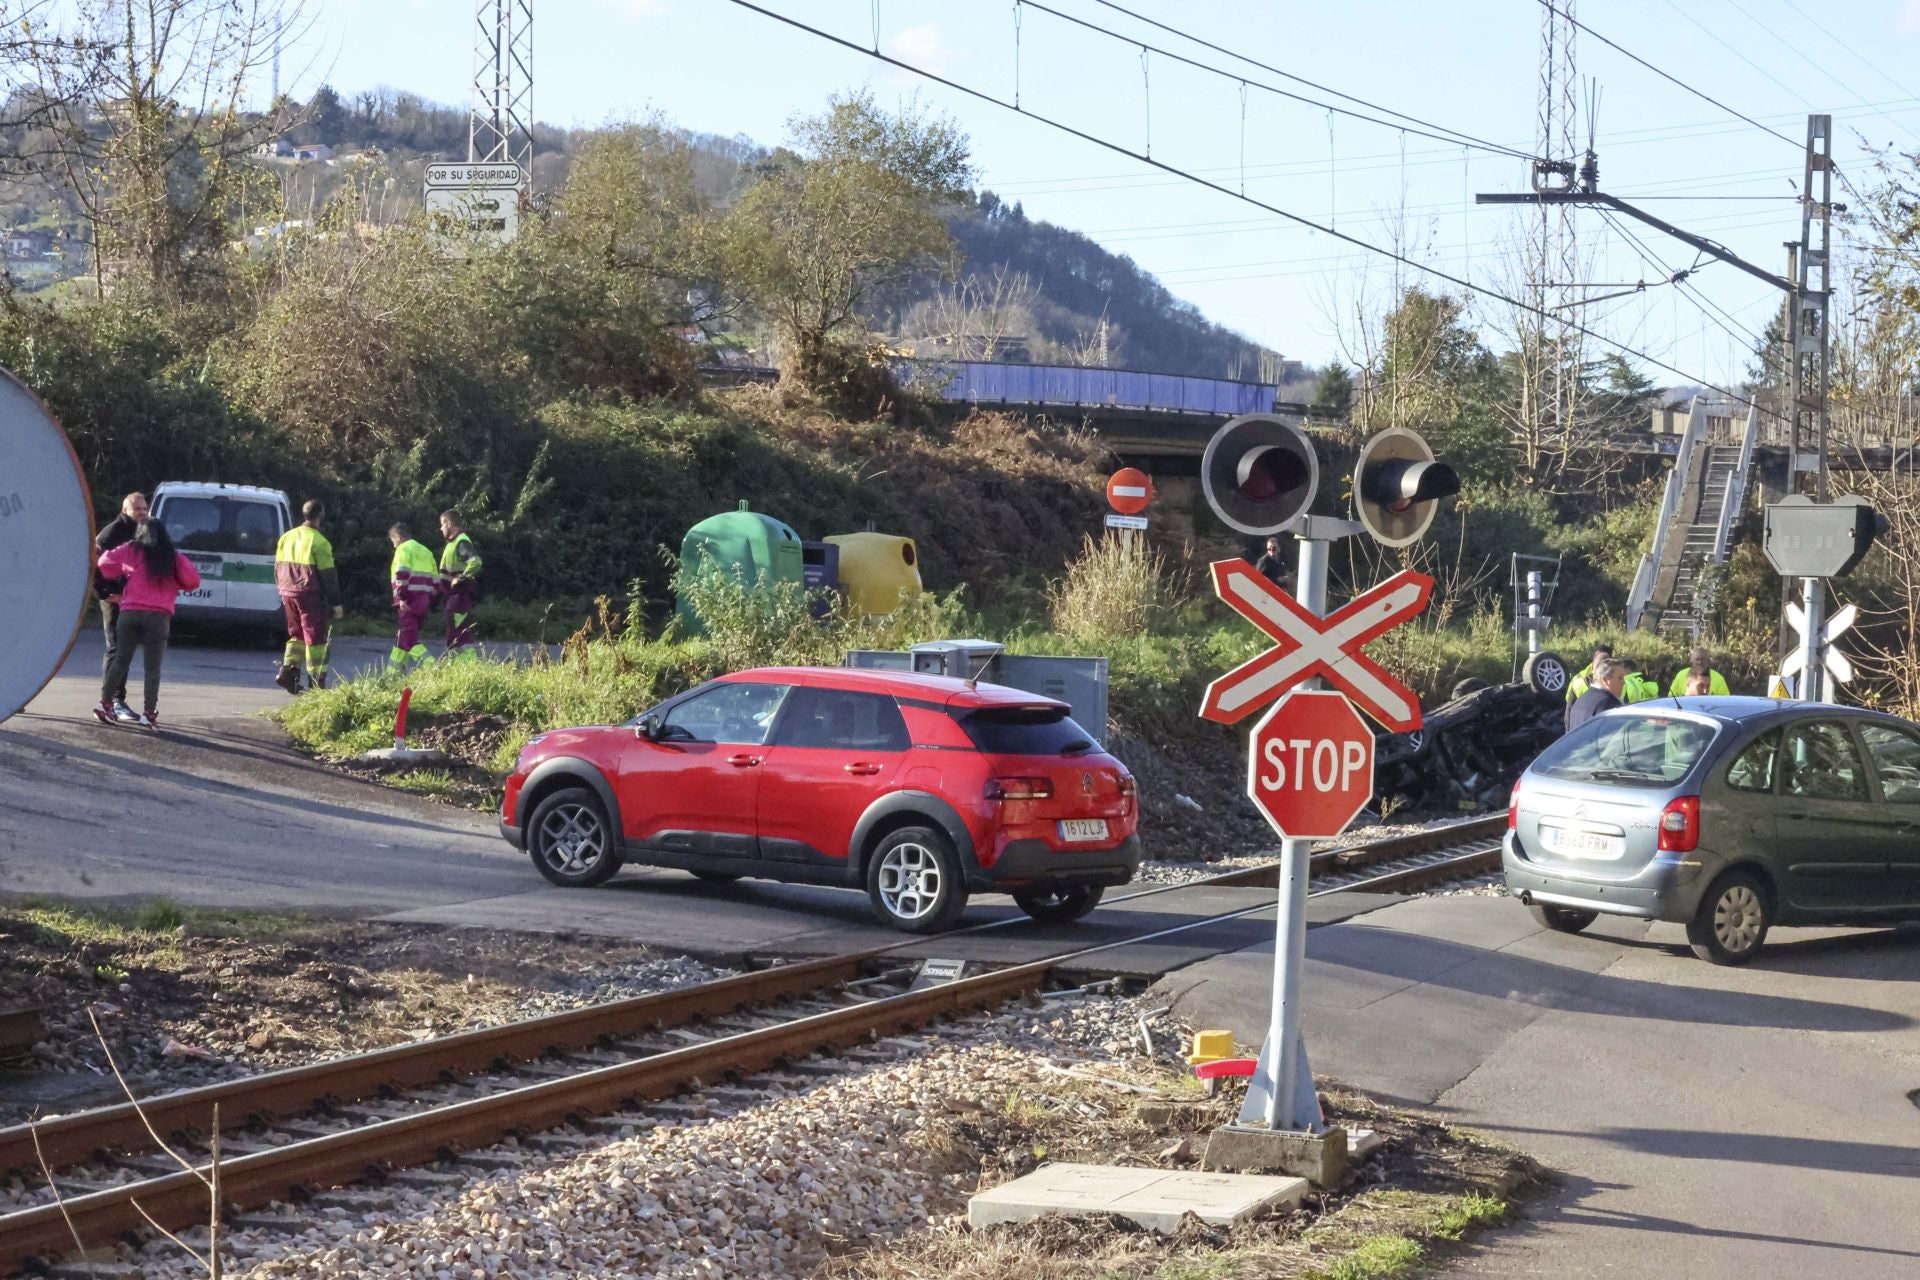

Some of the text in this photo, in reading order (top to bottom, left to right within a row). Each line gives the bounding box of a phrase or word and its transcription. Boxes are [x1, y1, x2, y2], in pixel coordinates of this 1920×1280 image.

[428, 170, 518, 180] POR SU SEGURIDAD
[1261, 737, 1366, 793] STOP
[1587, 836, 1609, 851] FRM
